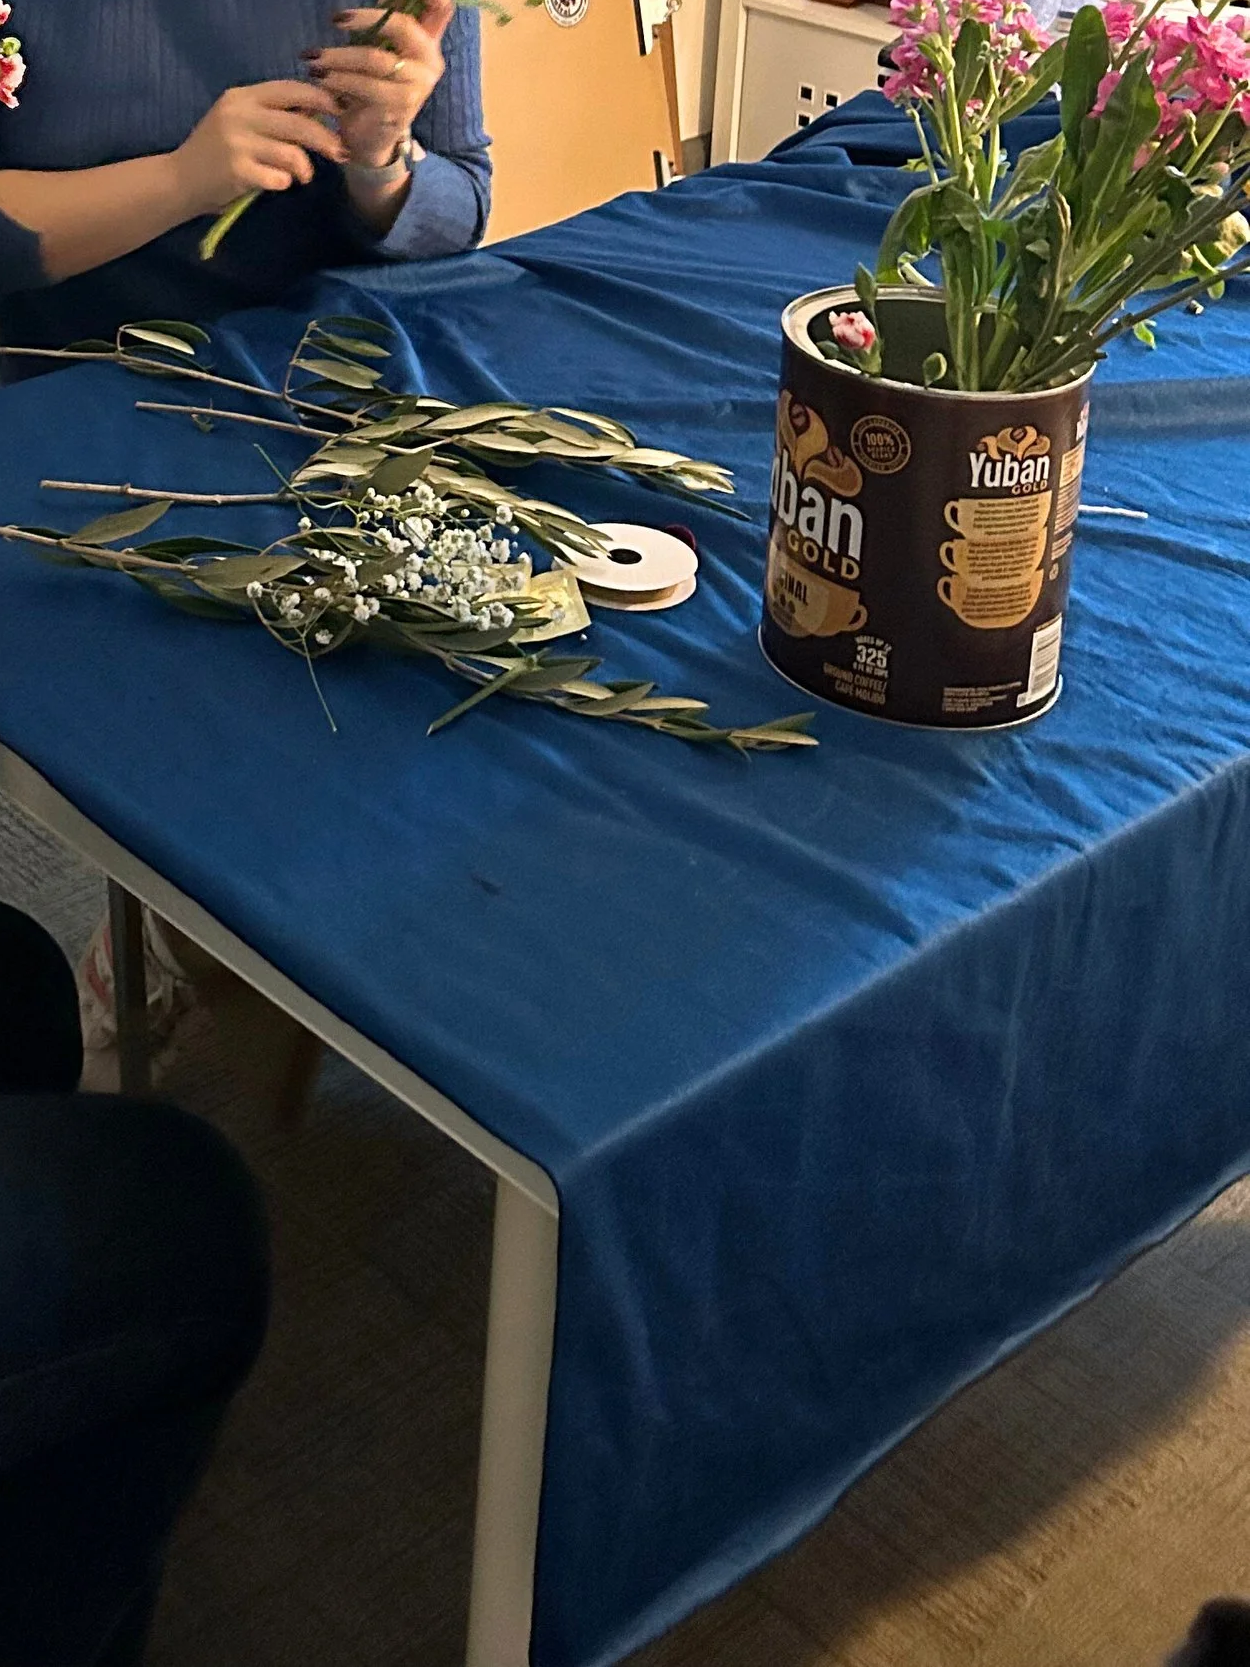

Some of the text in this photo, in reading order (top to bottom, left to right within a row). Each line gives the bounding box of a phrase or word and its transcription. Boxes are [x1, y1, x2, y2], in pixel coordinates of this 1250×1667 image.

[866, 433, 894, 446] 100%
[969, 451, 1050, 488] Yuban
[1011, 479, 1048, 495] GOLD
[770, 448, 863, 561] uban
[786, 529, 860, 580] GOLD
[856, 645, 887, 668] 325
